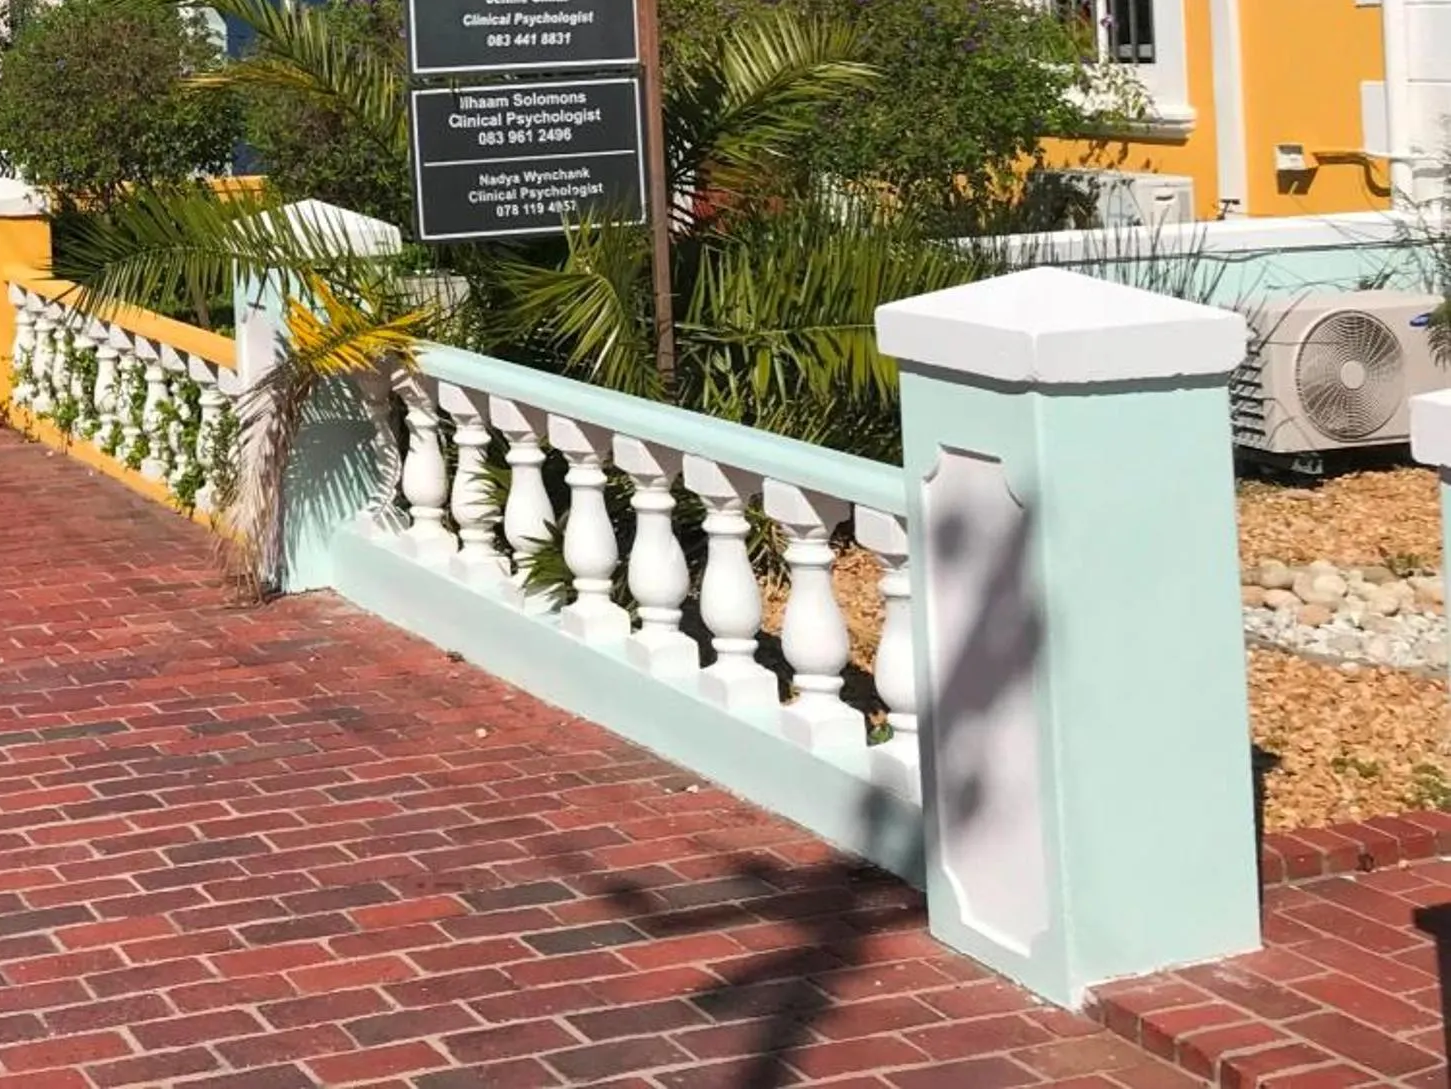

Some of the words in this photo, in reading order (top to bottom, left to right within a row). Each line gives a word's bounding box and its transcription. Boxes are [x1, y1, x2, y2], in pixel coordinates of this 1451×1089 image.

[463, 13, 511, 26] Clinical
[513, 10, 594, 27] Psychologist
[487, 34, 510, 47] 083
[514, 33, 537, 45] 441
[513, 92, 587, 107] Solomons
[448, 113, 502, 128] Clinical
[506, 108, 601, 127] Psychologist
[478, 131, 504, 145] 083
[508, 129, 533, 143] 961
[537, 127, 572, 142] 2496
[478, 174, 520, 186] Nadya
[523, 167, 590, 184] Wynchank
[468, 189, 517, 203] Clinical
[520, 182, 604, 200] Psychologist
[496, 204, 519, 217] 078
[522, 202, 544, 215] 119
